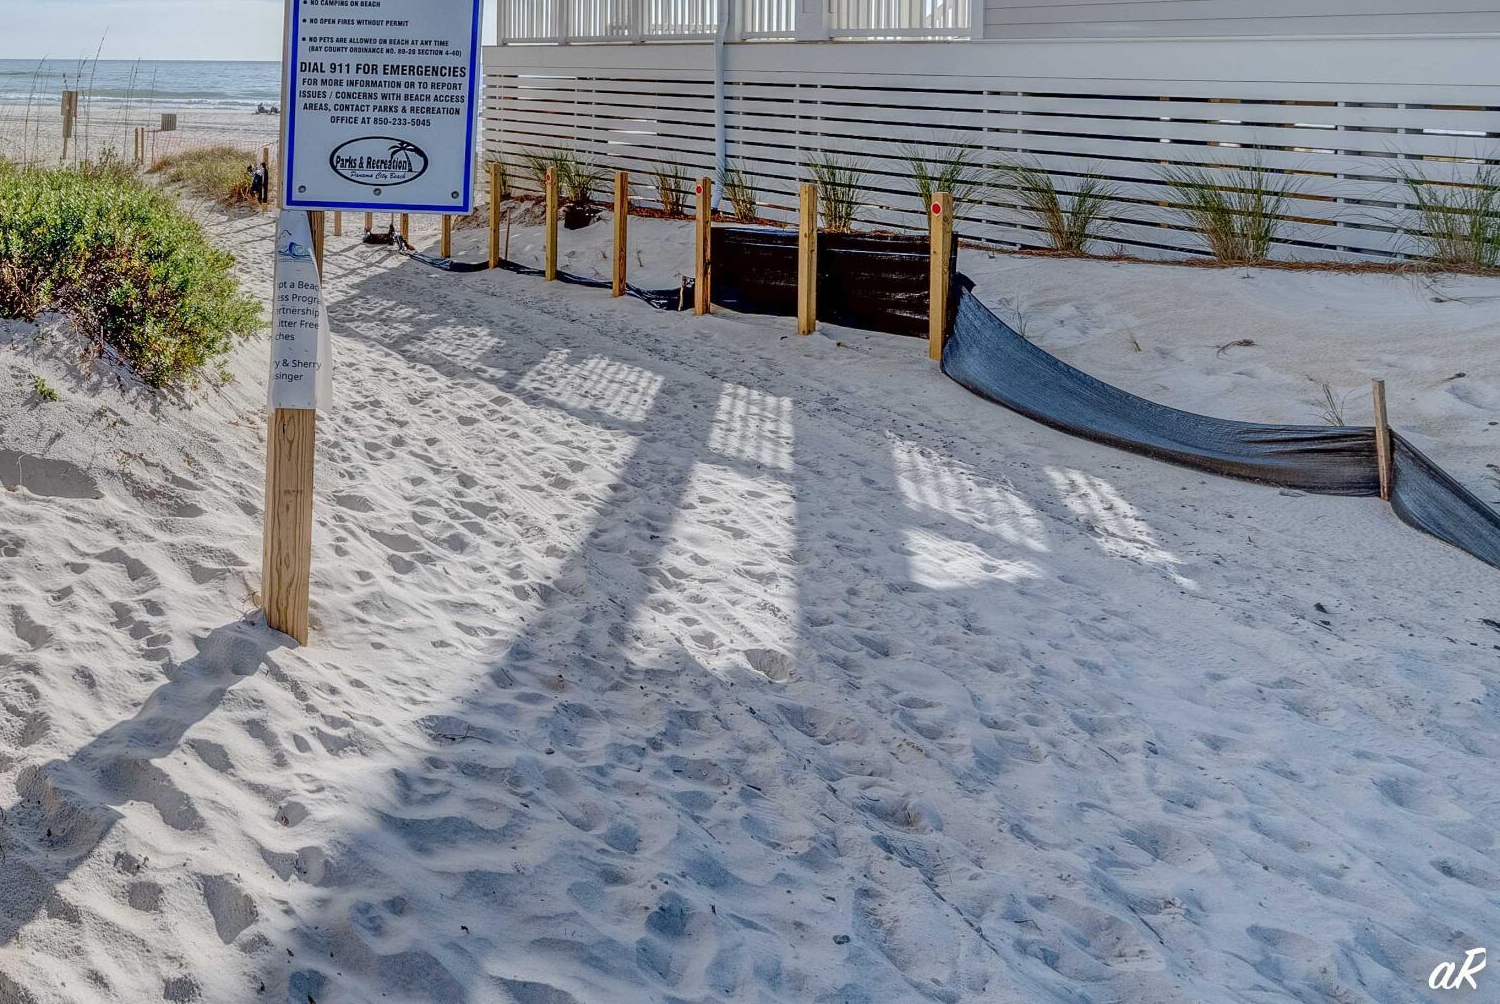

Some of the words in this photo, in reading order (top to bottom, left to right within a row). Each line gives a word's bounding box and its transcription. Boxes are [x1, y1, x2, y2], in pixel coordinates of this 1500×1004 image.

[300, 63, 324, 74] DIAL
[329, 63, 349, 74] 911
[355, 64, 378, 75] FOR
[382, 65, 466, 77] EMERGENCIES
[302, 78, 318, 86] FOR
[346, 80, 401, 88] INFORMATION
[403, 81, 415, 89] OR
[418, 81, 428, 89] TO
[430, 82, 462, 90] REPORT
[299, 91, 326, 99] ISSUES
[335, 92, 378, 100] CONCERNS
[380, 93, 401, 101] WITH
[403, 94, 430, 102] BEACH
[433, 94, 465, 102] ACCESS
[303, 103, 332, 112] AREAS,
[333, 104, 369, 112] CONTACT
[372, 105, 398, 113] PARKS
[401, 106, 406, 114] &
[409, 106, 460, 115] RECREATION
[330, 116, 358, 124] OFFICE
[360, 117, 370, 125] AT
[373, 117, 431, 126] 850-233-5045
[335, 156, 356, 169] Parks
[358, 156, 363, 169] &
[366, 156, 407, 170] Recreation
[277, 281, 287, 291] pt
[278, 319, 297, 328] itter
[300, 320, 319, 329] Free
[282, 359, 289, 367] &
[292, 359, 322, 371] Sherry
